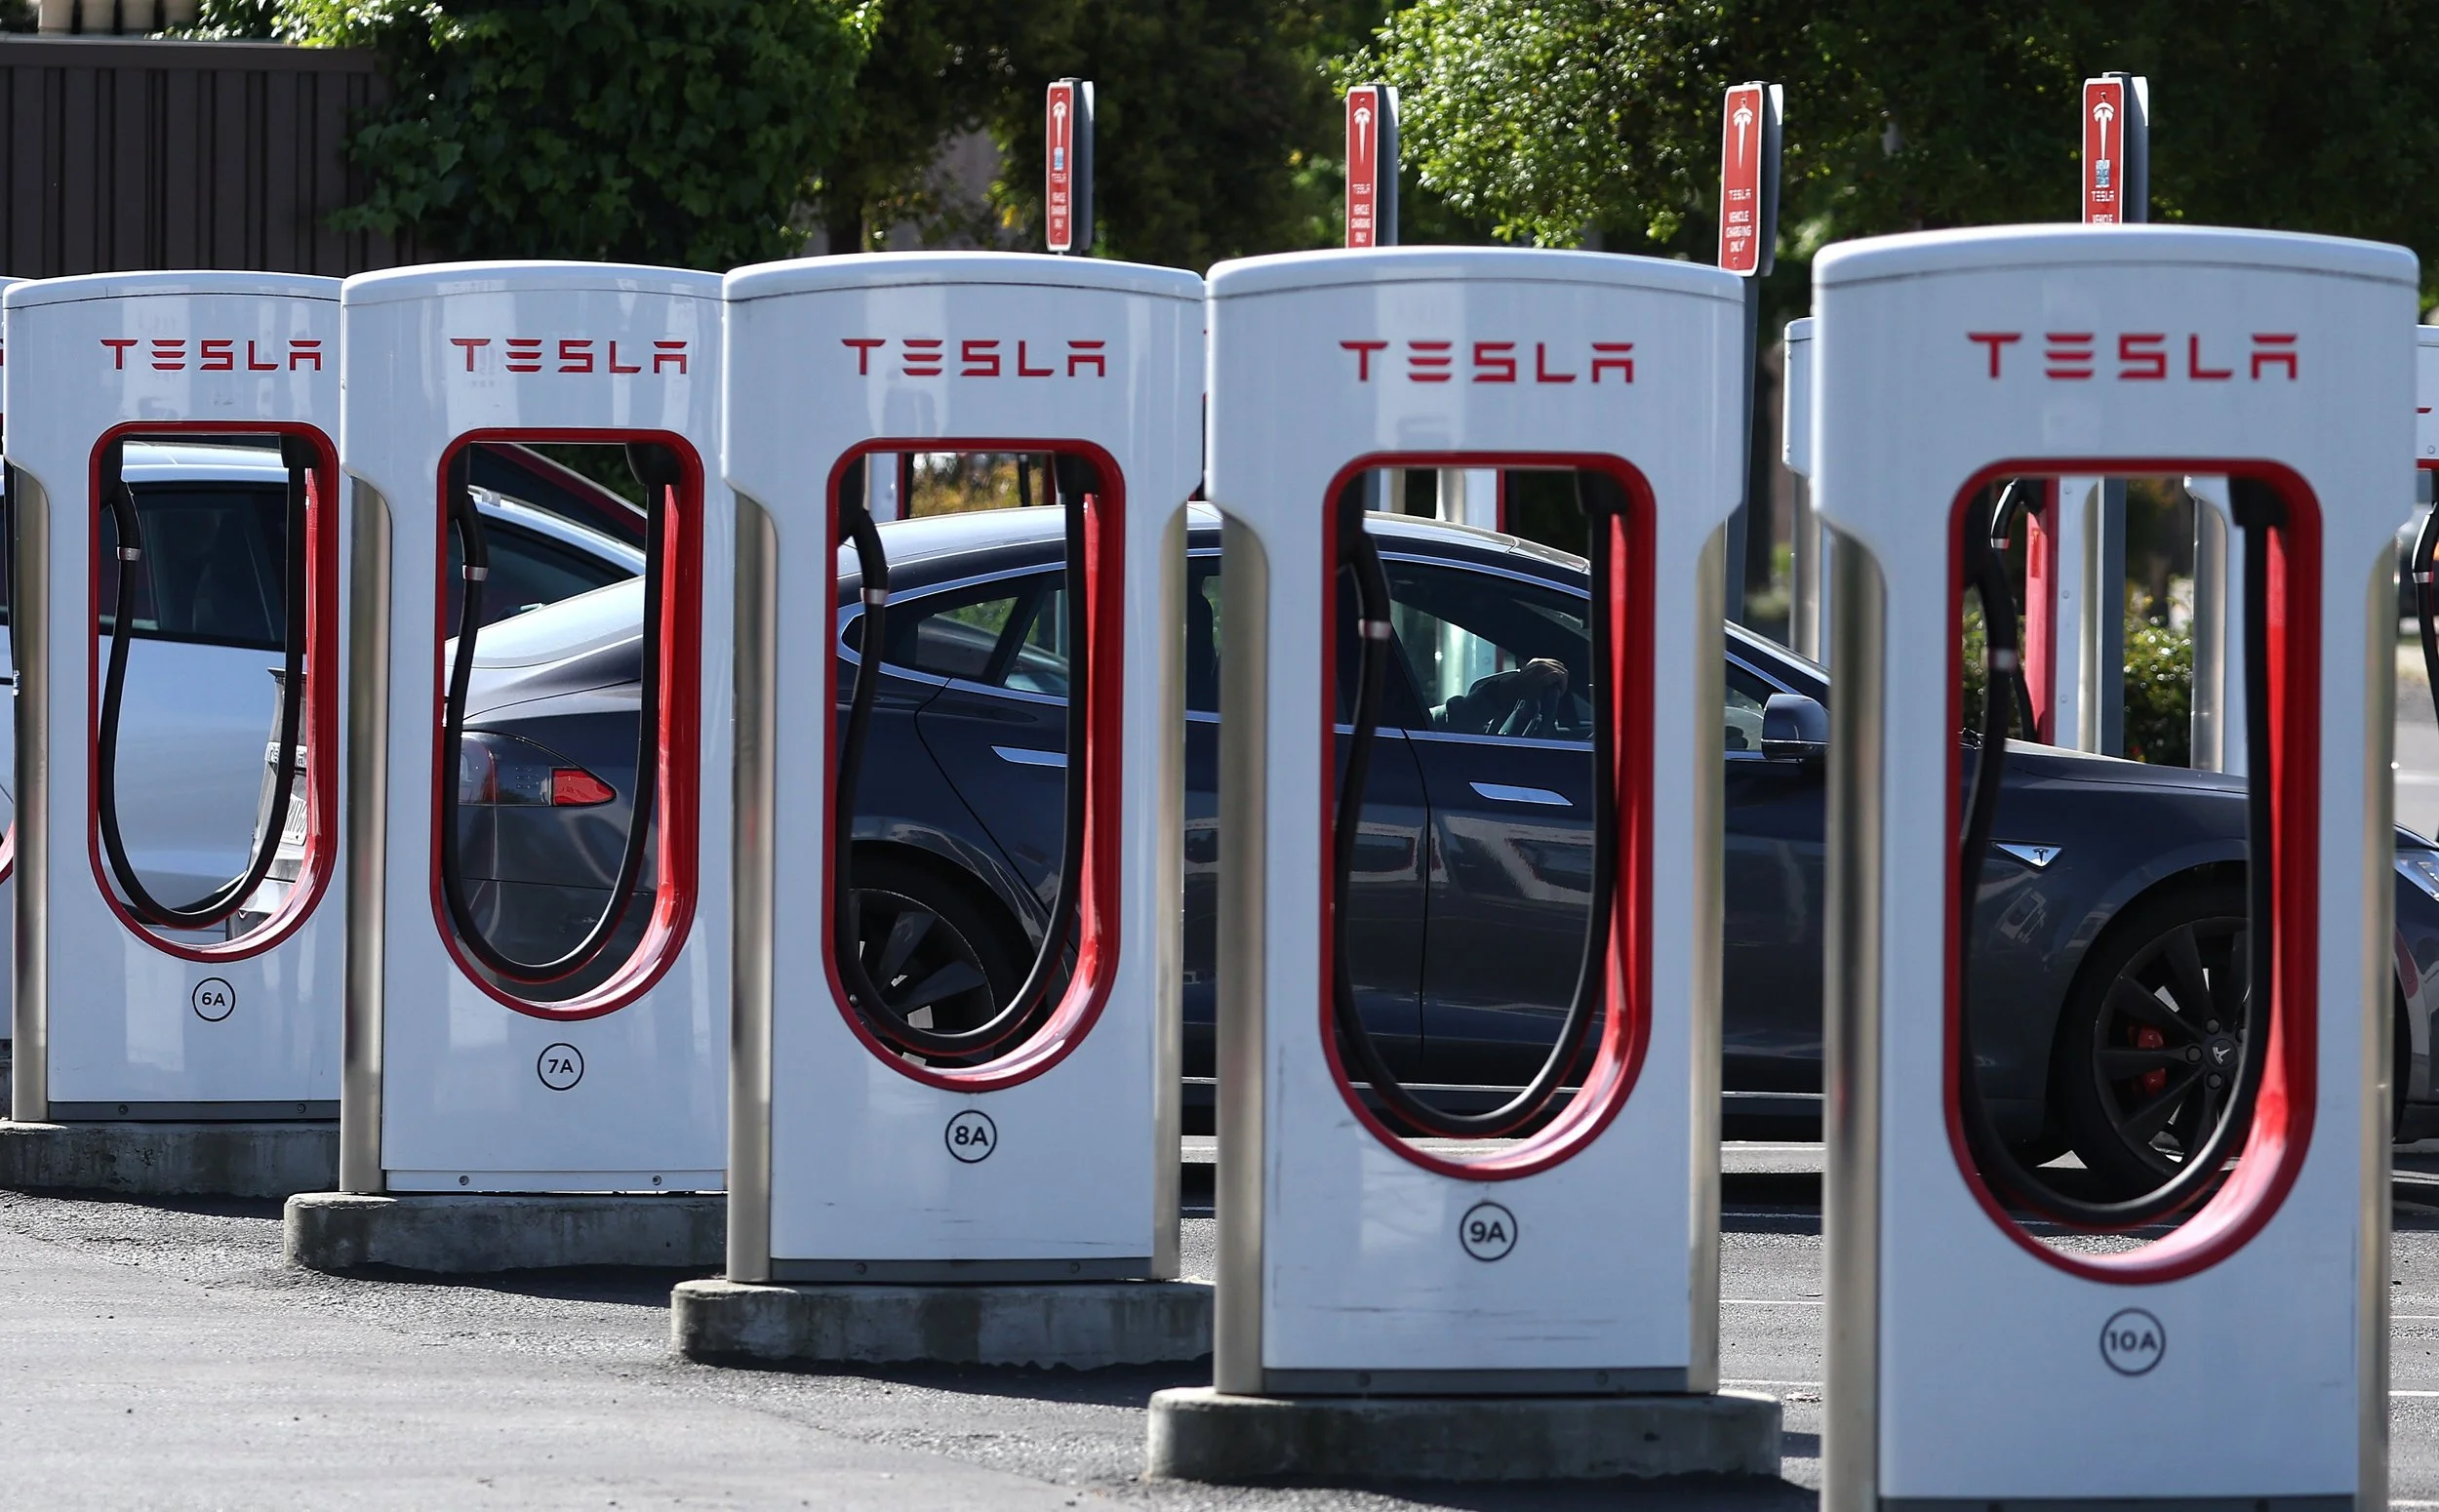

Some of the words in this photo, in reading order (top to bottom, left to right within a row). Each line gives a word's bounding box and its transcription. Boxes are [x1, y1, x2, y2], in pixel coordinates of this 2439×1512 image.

[100, 338, 322, 371] TESLA
[451, 338, 688, 374] TESLA
[842, 338, 1105, 378] TESLA
[1339, 340, 1634, 383] TESLA
[1968, 333, 2299, 380] TESLA
[201, 991, 226, 1007] 6A
[548, 1058, 575, 1074] 7A
[954, 1125, 989, 1147] 8A
[1469, 1220, 1507, 1245] 9A
[2109, 1330, 2158, 1353] 10A
